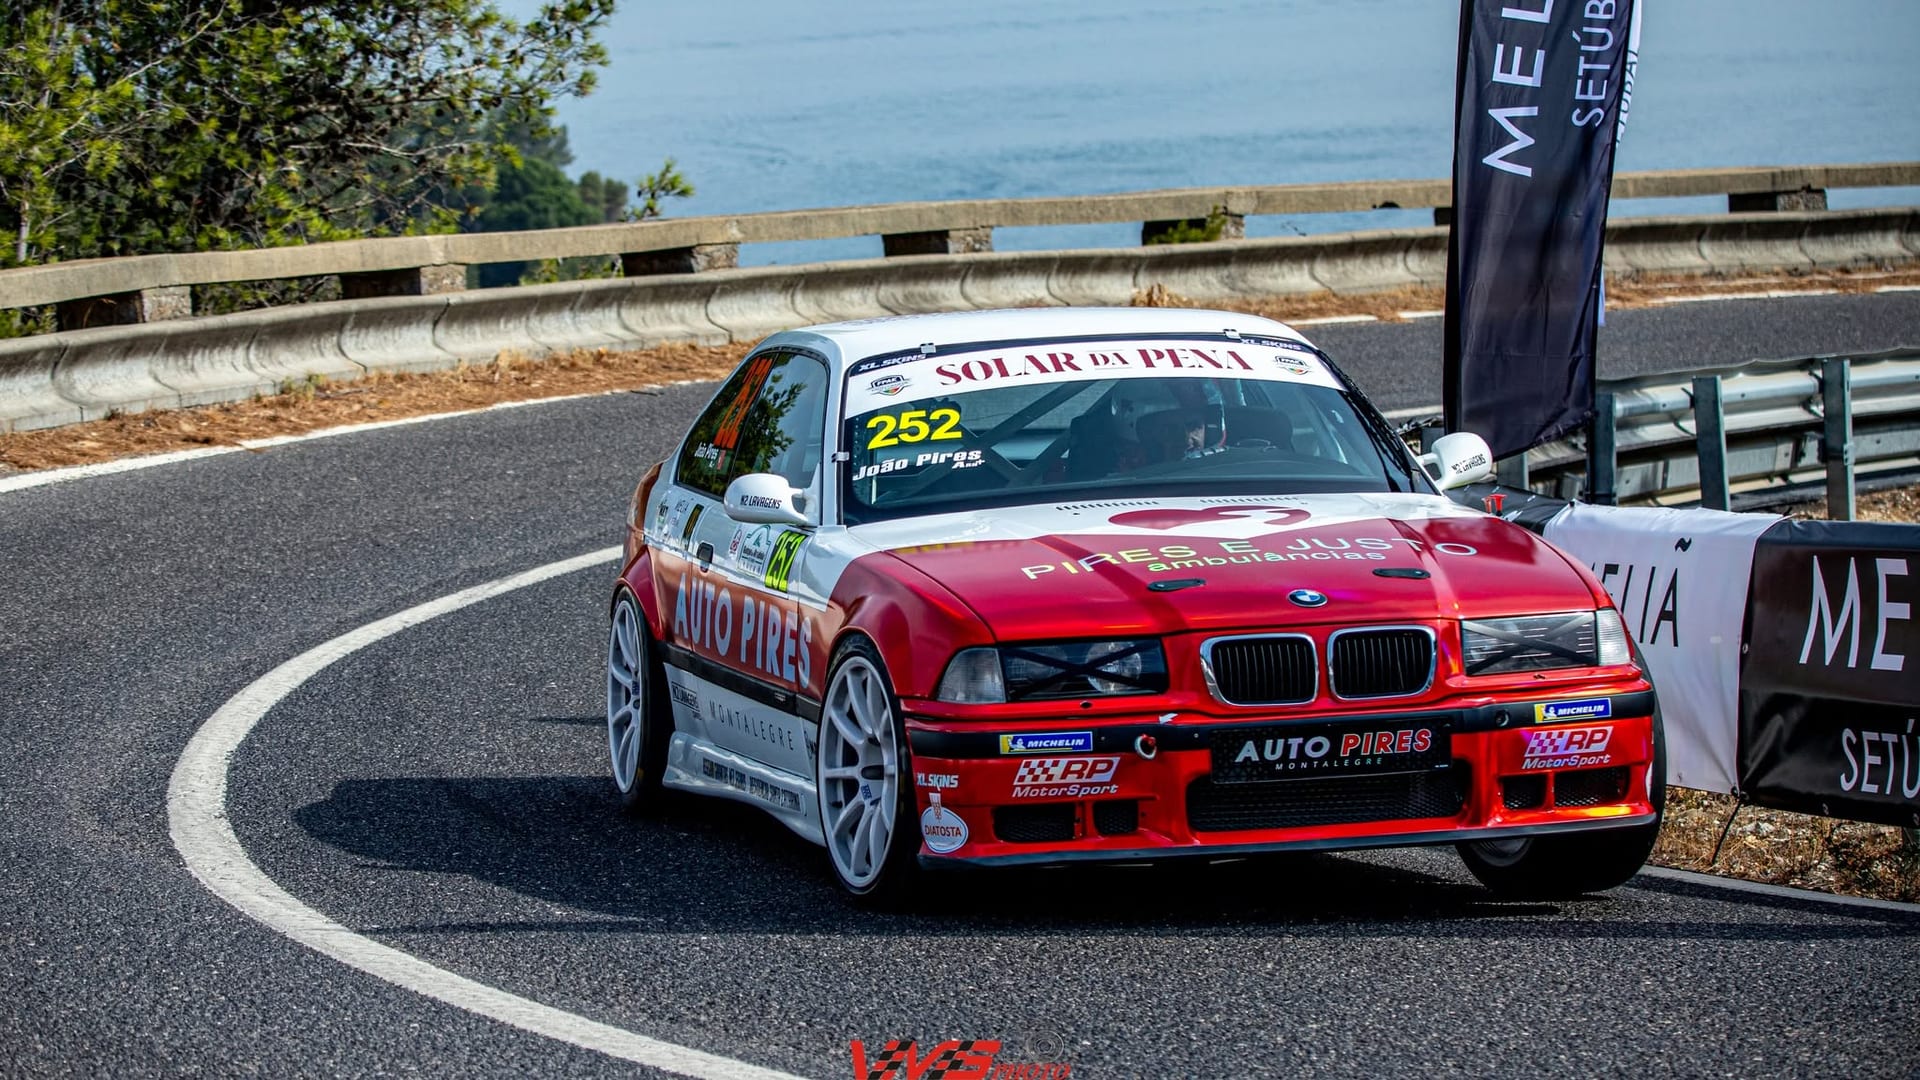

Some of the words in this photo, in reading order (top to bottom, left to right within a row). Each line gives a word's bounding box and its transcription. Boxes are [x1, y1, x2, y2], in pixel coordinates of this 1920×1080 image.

[1571, 0, 1617, 127] SETÚB
[936, 352, 1083, 386] SOLAR
[1089, 352, 1129, 366] DA
[1136, 348, 1254, 371] PENA
[866, 408, 963, 450] 252
[852, 458, 909, 481] João
[764, 530, 807, 592] 252
[1021, 545, 1198, 580] PIRES
[1218, 540, 1260, 553] E
[1286, 537, 1478, 556] JUSTO
[1147, 550, 1386, 572] ambulâncias
[674, 572, 733, 656] AUTO
[740, 595, 812, 689] PIRES
[1557, 704, 1605, 716] MICHELIN
[709, 700, 794, 751] MONTALEGRE
[1027, 738, 1085, 748] MICHELIN
[1234, 736, 1331, 763] AUTO
[1340, 728, 1432, 757] PIRES
[1562, 728, 1609, 752] RP
[1060, 759, 1115, 780] RP
[1275, 757, 1383, 770] MONTALEGRE
[1522, 754, 1611, 769] MotorSport
[1012, 784, 1119, 797] MotorSport
[924, 824, 962, 837] DIATOSTA
